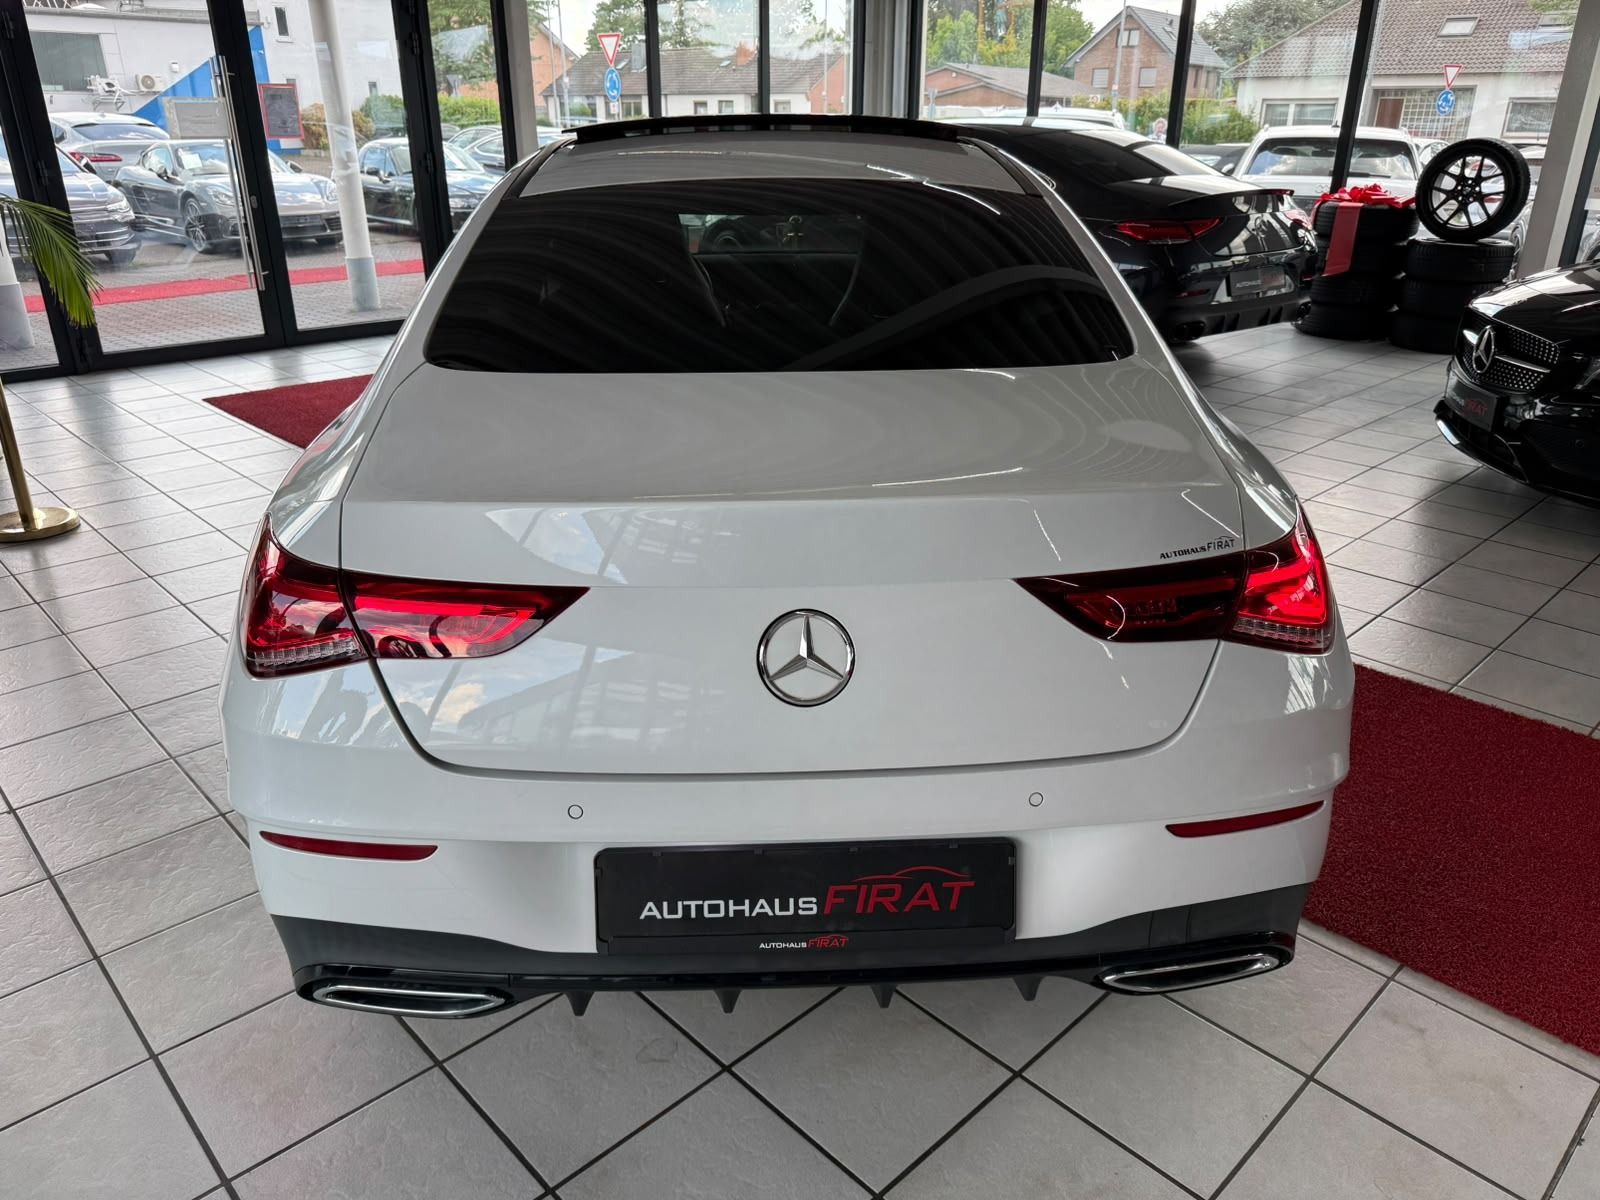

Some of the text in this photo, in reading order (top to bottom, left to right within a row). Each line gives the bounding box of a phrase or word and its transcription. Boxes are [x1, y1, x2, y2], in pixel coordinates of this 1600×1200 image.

[1160, 539, 1235, 559] AUTOHAUS FIRAT
[639, 880, 976, 920] AUTOHAUS FIRAT
[759, 938, 848, 949] AUTOHAUS FIRAT
